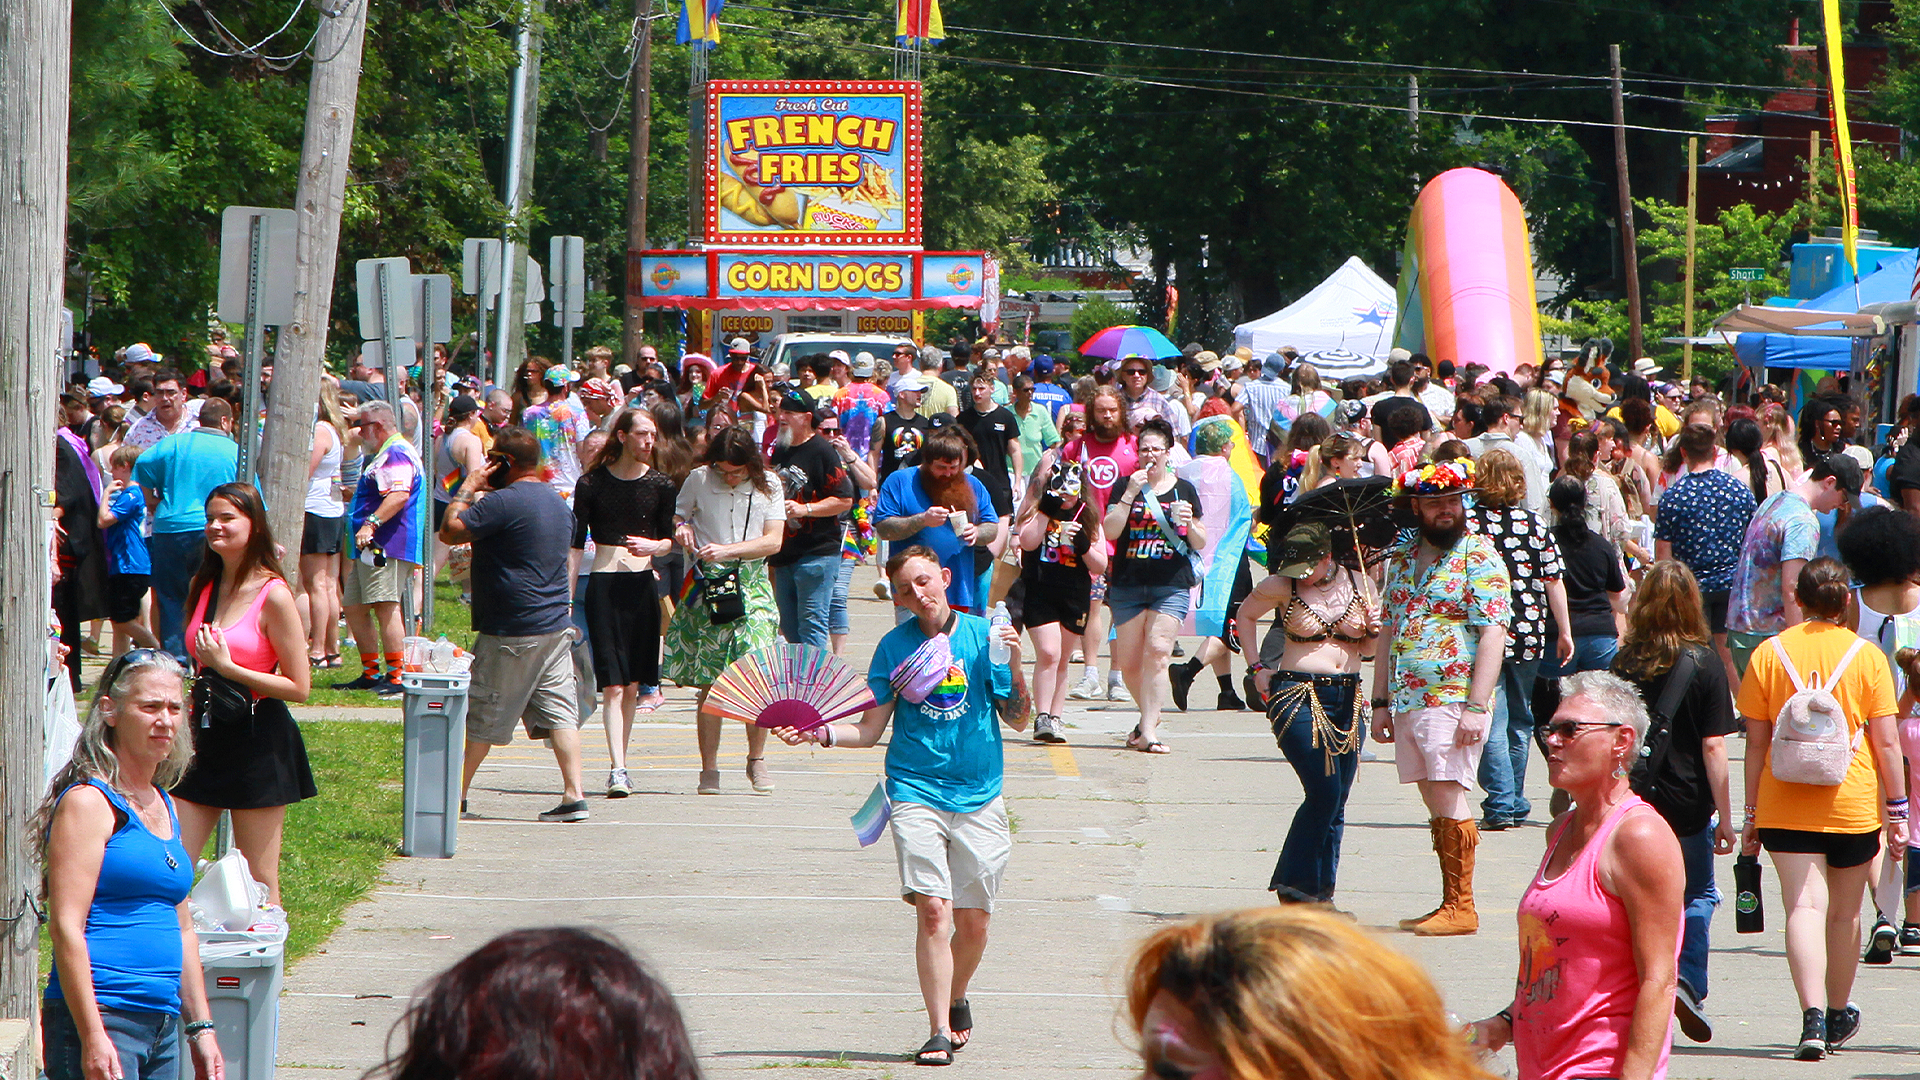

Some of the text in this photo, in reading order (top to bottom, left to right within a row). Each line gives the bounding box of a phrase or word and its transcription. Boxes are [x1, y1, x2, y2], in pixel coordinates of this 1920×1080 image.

[774, 97, 848, 112] Fresh Cut
[726, 114, 897, 152] FRENCH
[759, 152, 864, 185] FRIES
[727, 261, 903, 292] CORN DOGS
[1731, 270, 1755, 280] Short
[721, 317, 773, 331] ICE COLD
[857, 316, 911, 331] ICE COLD
[1092, 464, 1114, 481] YS
[1125, 539, 1174, 560] HUGS
[920, 701, 971, 721] GAY DAY!
